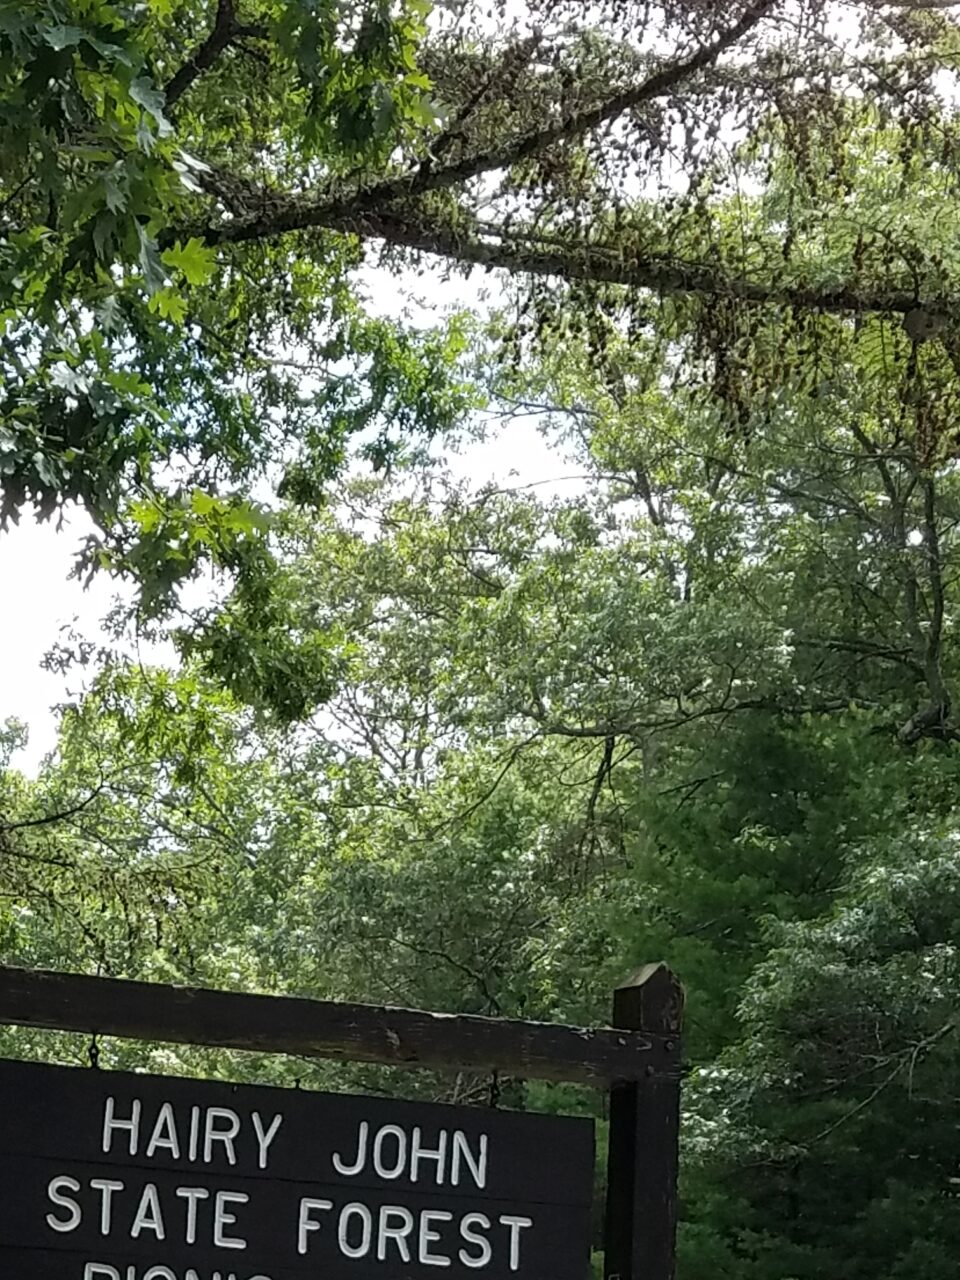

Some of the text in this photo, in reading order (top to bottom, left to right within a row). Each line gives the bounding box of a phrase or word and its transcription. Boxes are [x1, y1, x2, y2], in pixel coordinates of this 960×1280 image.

[102, 1097, 488, 1189] HAIRY JOHN
[46, 1175, 533, 1271] STATE FOREST
